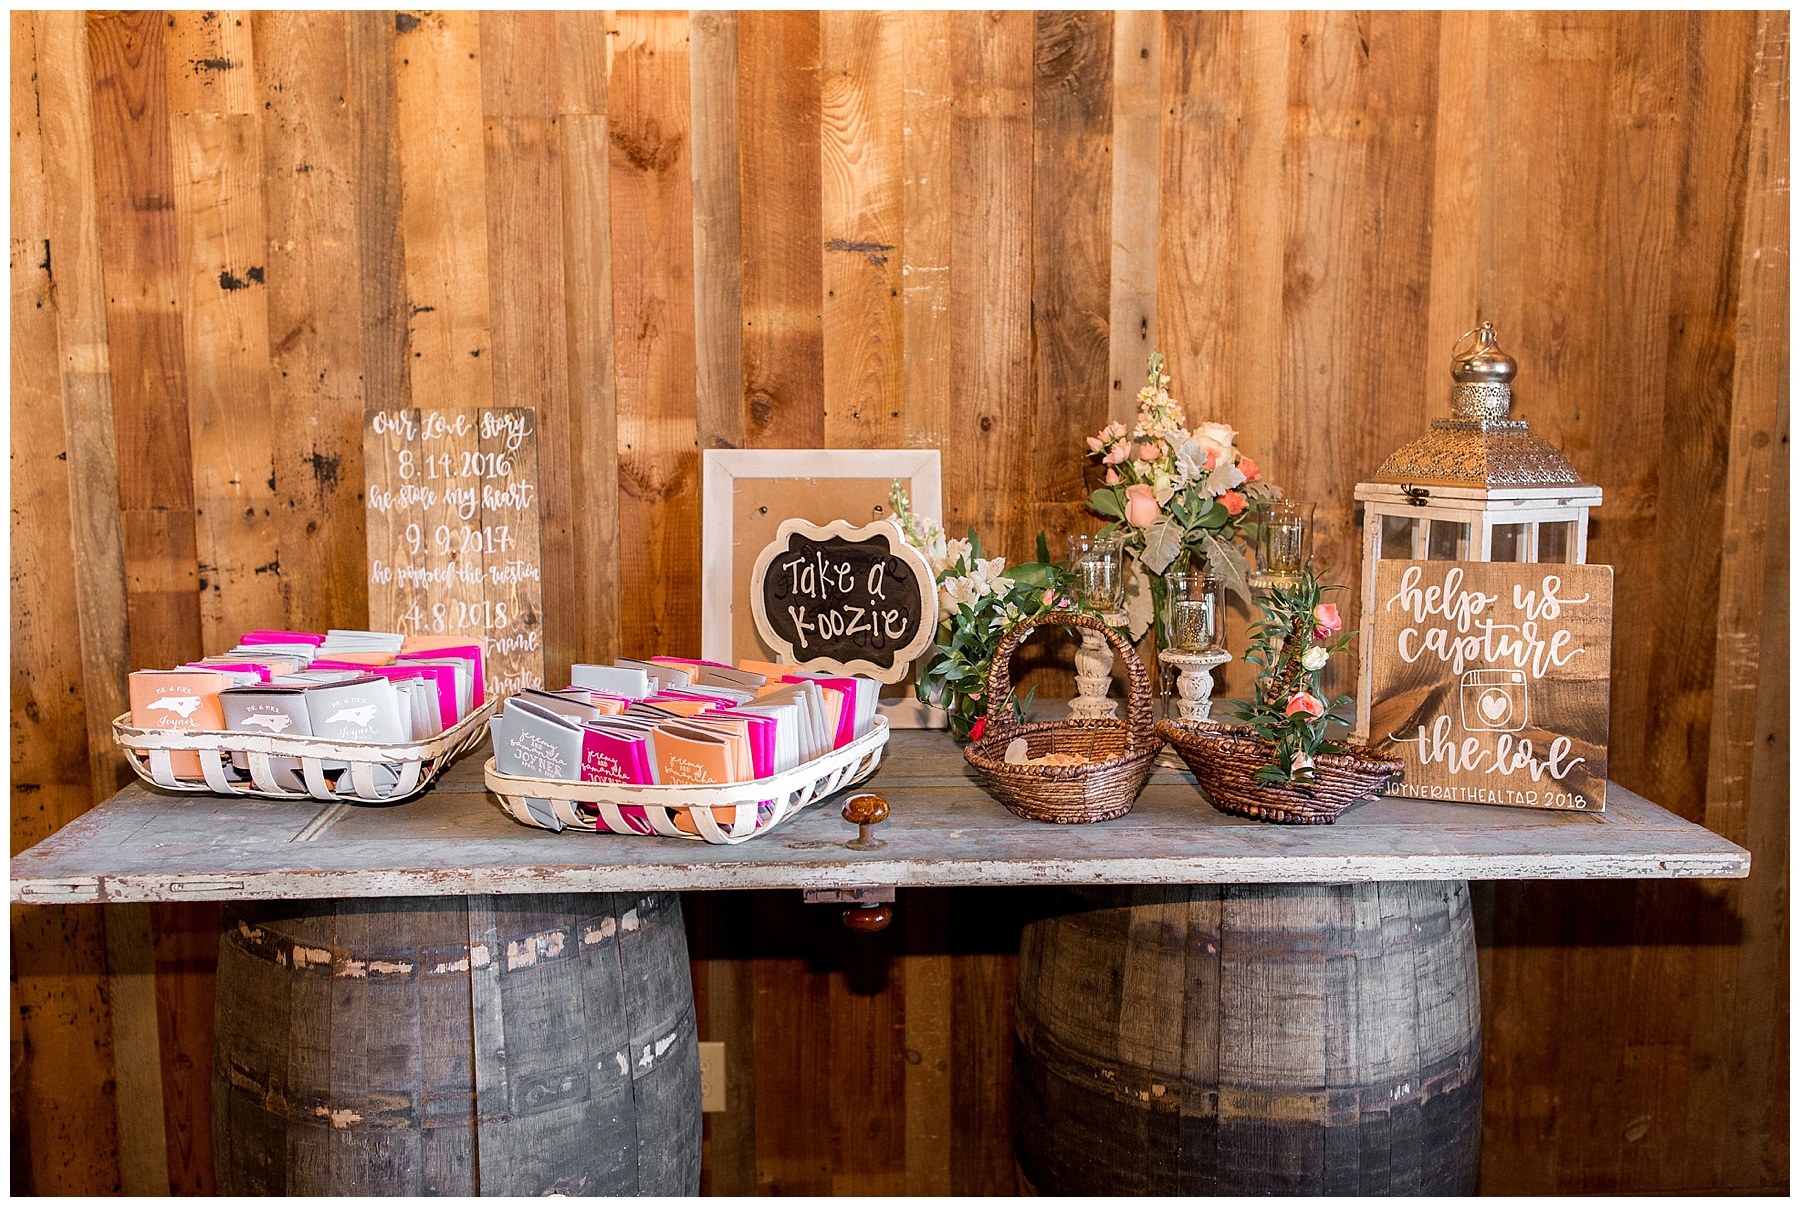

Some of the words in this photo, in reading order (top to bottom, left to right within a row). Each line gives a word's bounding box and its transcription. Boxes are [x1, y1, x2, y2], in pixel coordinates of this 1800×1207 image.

[373, 410, 417, 441] Our
[422, 411, 472, 441] Love
[480, 411, 533, 450] Story
[399, 450, 511, 480] 8.14.2016
[368, 484, 395, 512] he
[397, 484, 437, 511] stole
[442, 487, 478, 520] my
[482, 479, 534, 512] heart
[372, 560, 393, 586] he
[397, 561, 456, 590] popped
[455, 561, 488, 585] the
[489, 560, 540, 586] question
[782, 551, 855, 599] Take
[867, 561, 886, 600] a
[1386, 565, 1498, 633] help
[1513, 575, 1589, 621] us
[404, 600, 507, 633] 4.8.2018
[495, 631, 539, 656] name
[1398, 618, 1585, 679] capture
[485, 666, 545, 694] mantha
[156, 715, 200, 730] Joyner
[338, 726, 380, 741] Joyner
[510, 739, 568, 766] samantha
[519, 729, 558, 757] jeremy
[530, 742, 542, 750] AND
[1388, 715, 1491, 774] the
[1485, 734, 1585, 782] love
[514, 748, 562, 778] JOYNER
[581, 763, 630, 780] samantha
[587, 747, 618, 773] jeremy
[669, 752, 704, 778] jeremy
[664, 765, 718, 784] samantha
[1544, 792, 1587, 809] 2018
